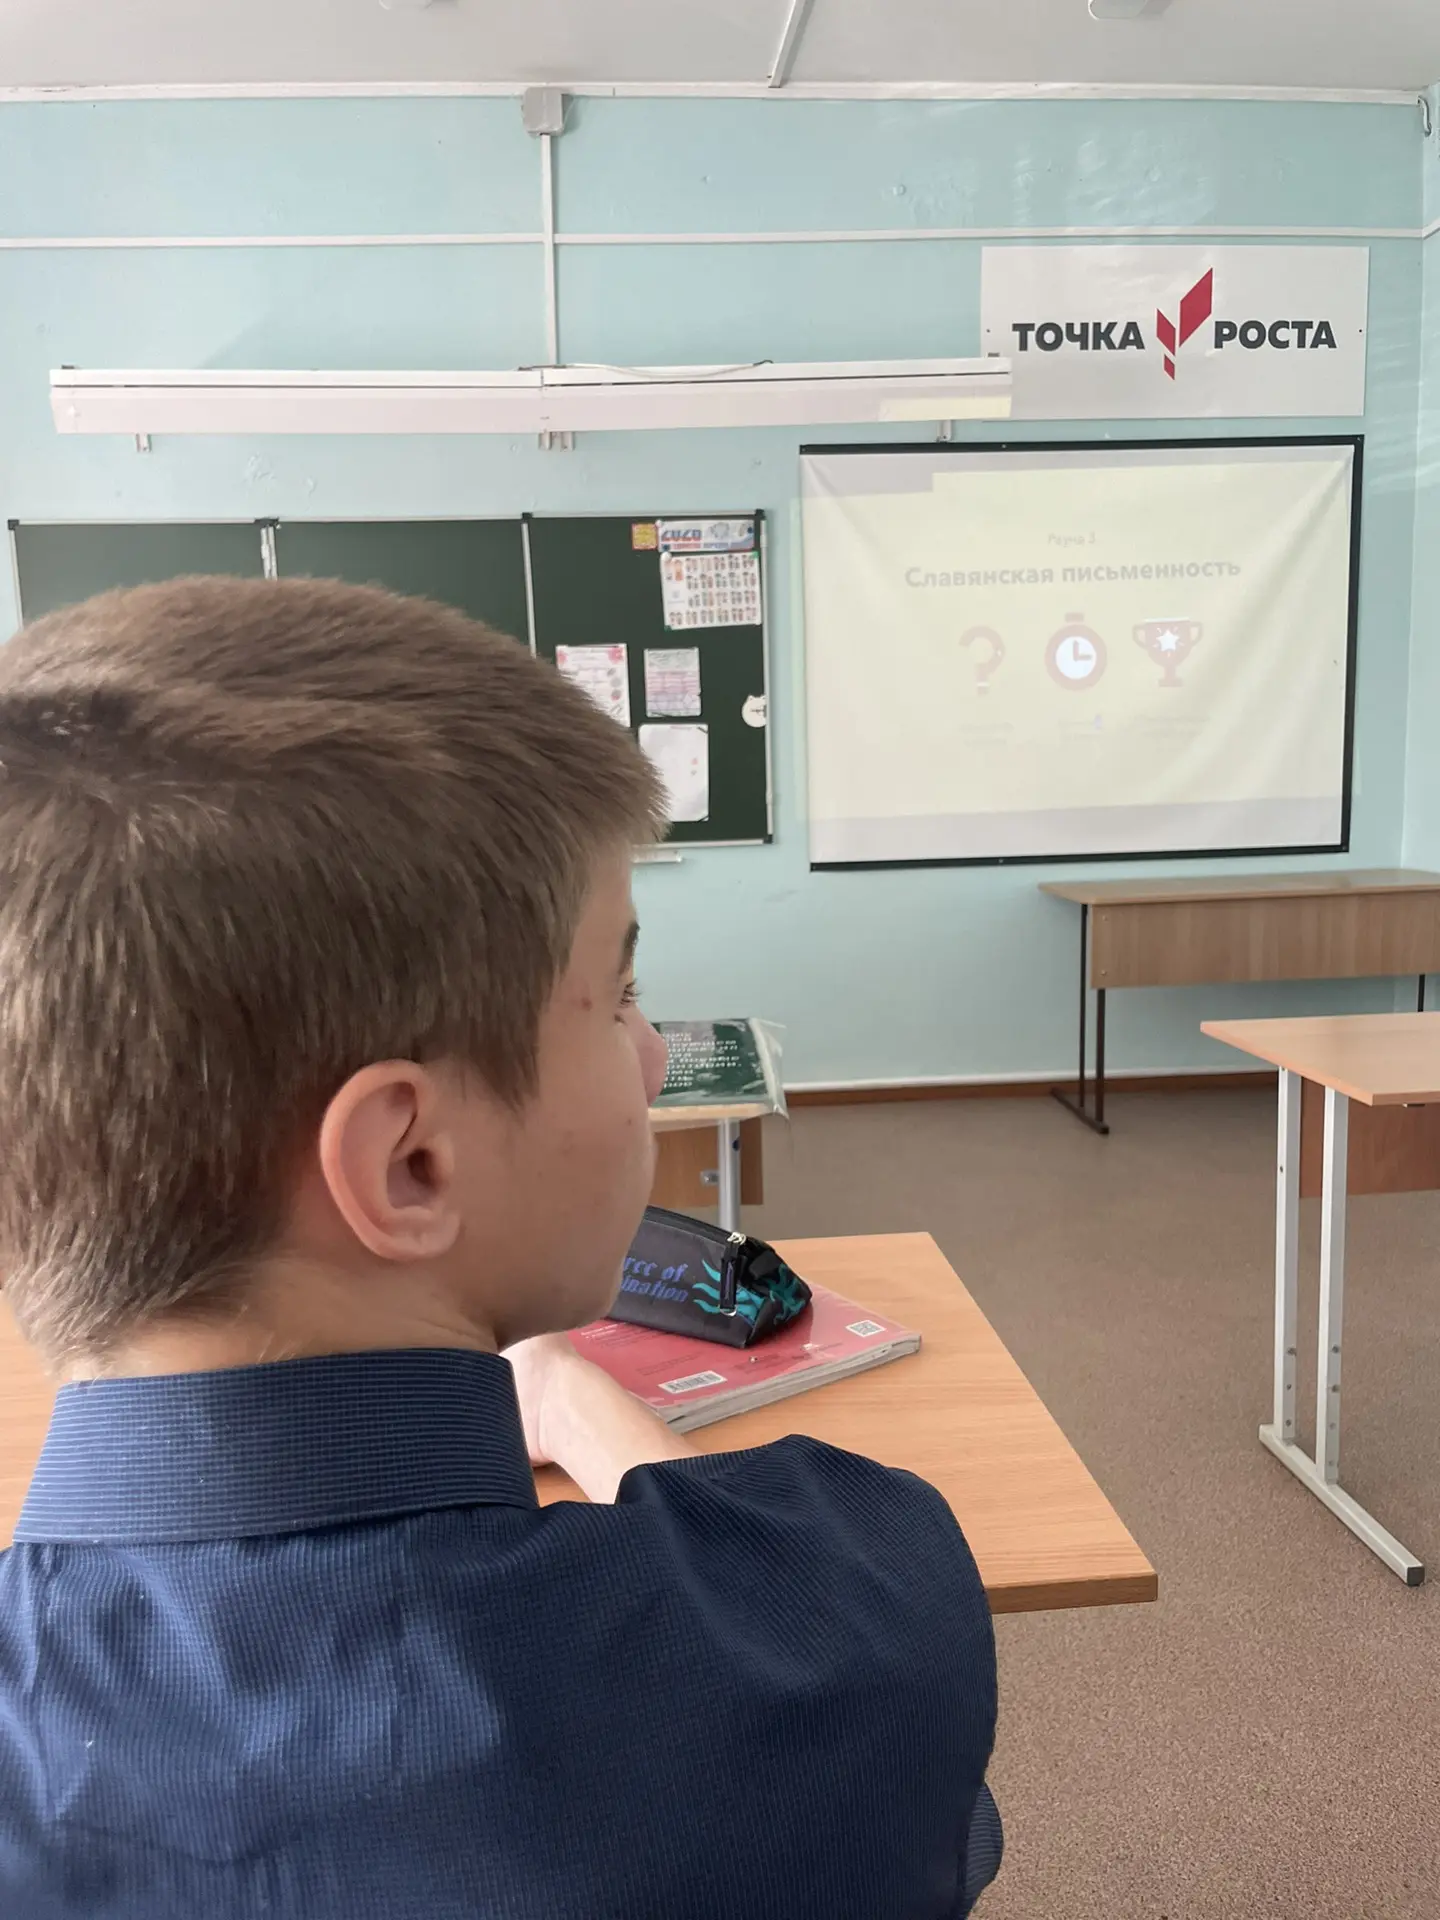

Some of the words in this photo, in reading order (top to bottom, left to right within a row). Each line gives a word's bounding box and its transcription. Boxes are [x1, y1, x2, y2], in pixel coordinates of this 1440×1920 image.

[1012, 322, 1146, 351] ТОЧКА
[1214, 320, 1337, 349] РОСТА
[904, 567, 1054, 588] Славянская
[1062, 559, 1242, 583] письменность
